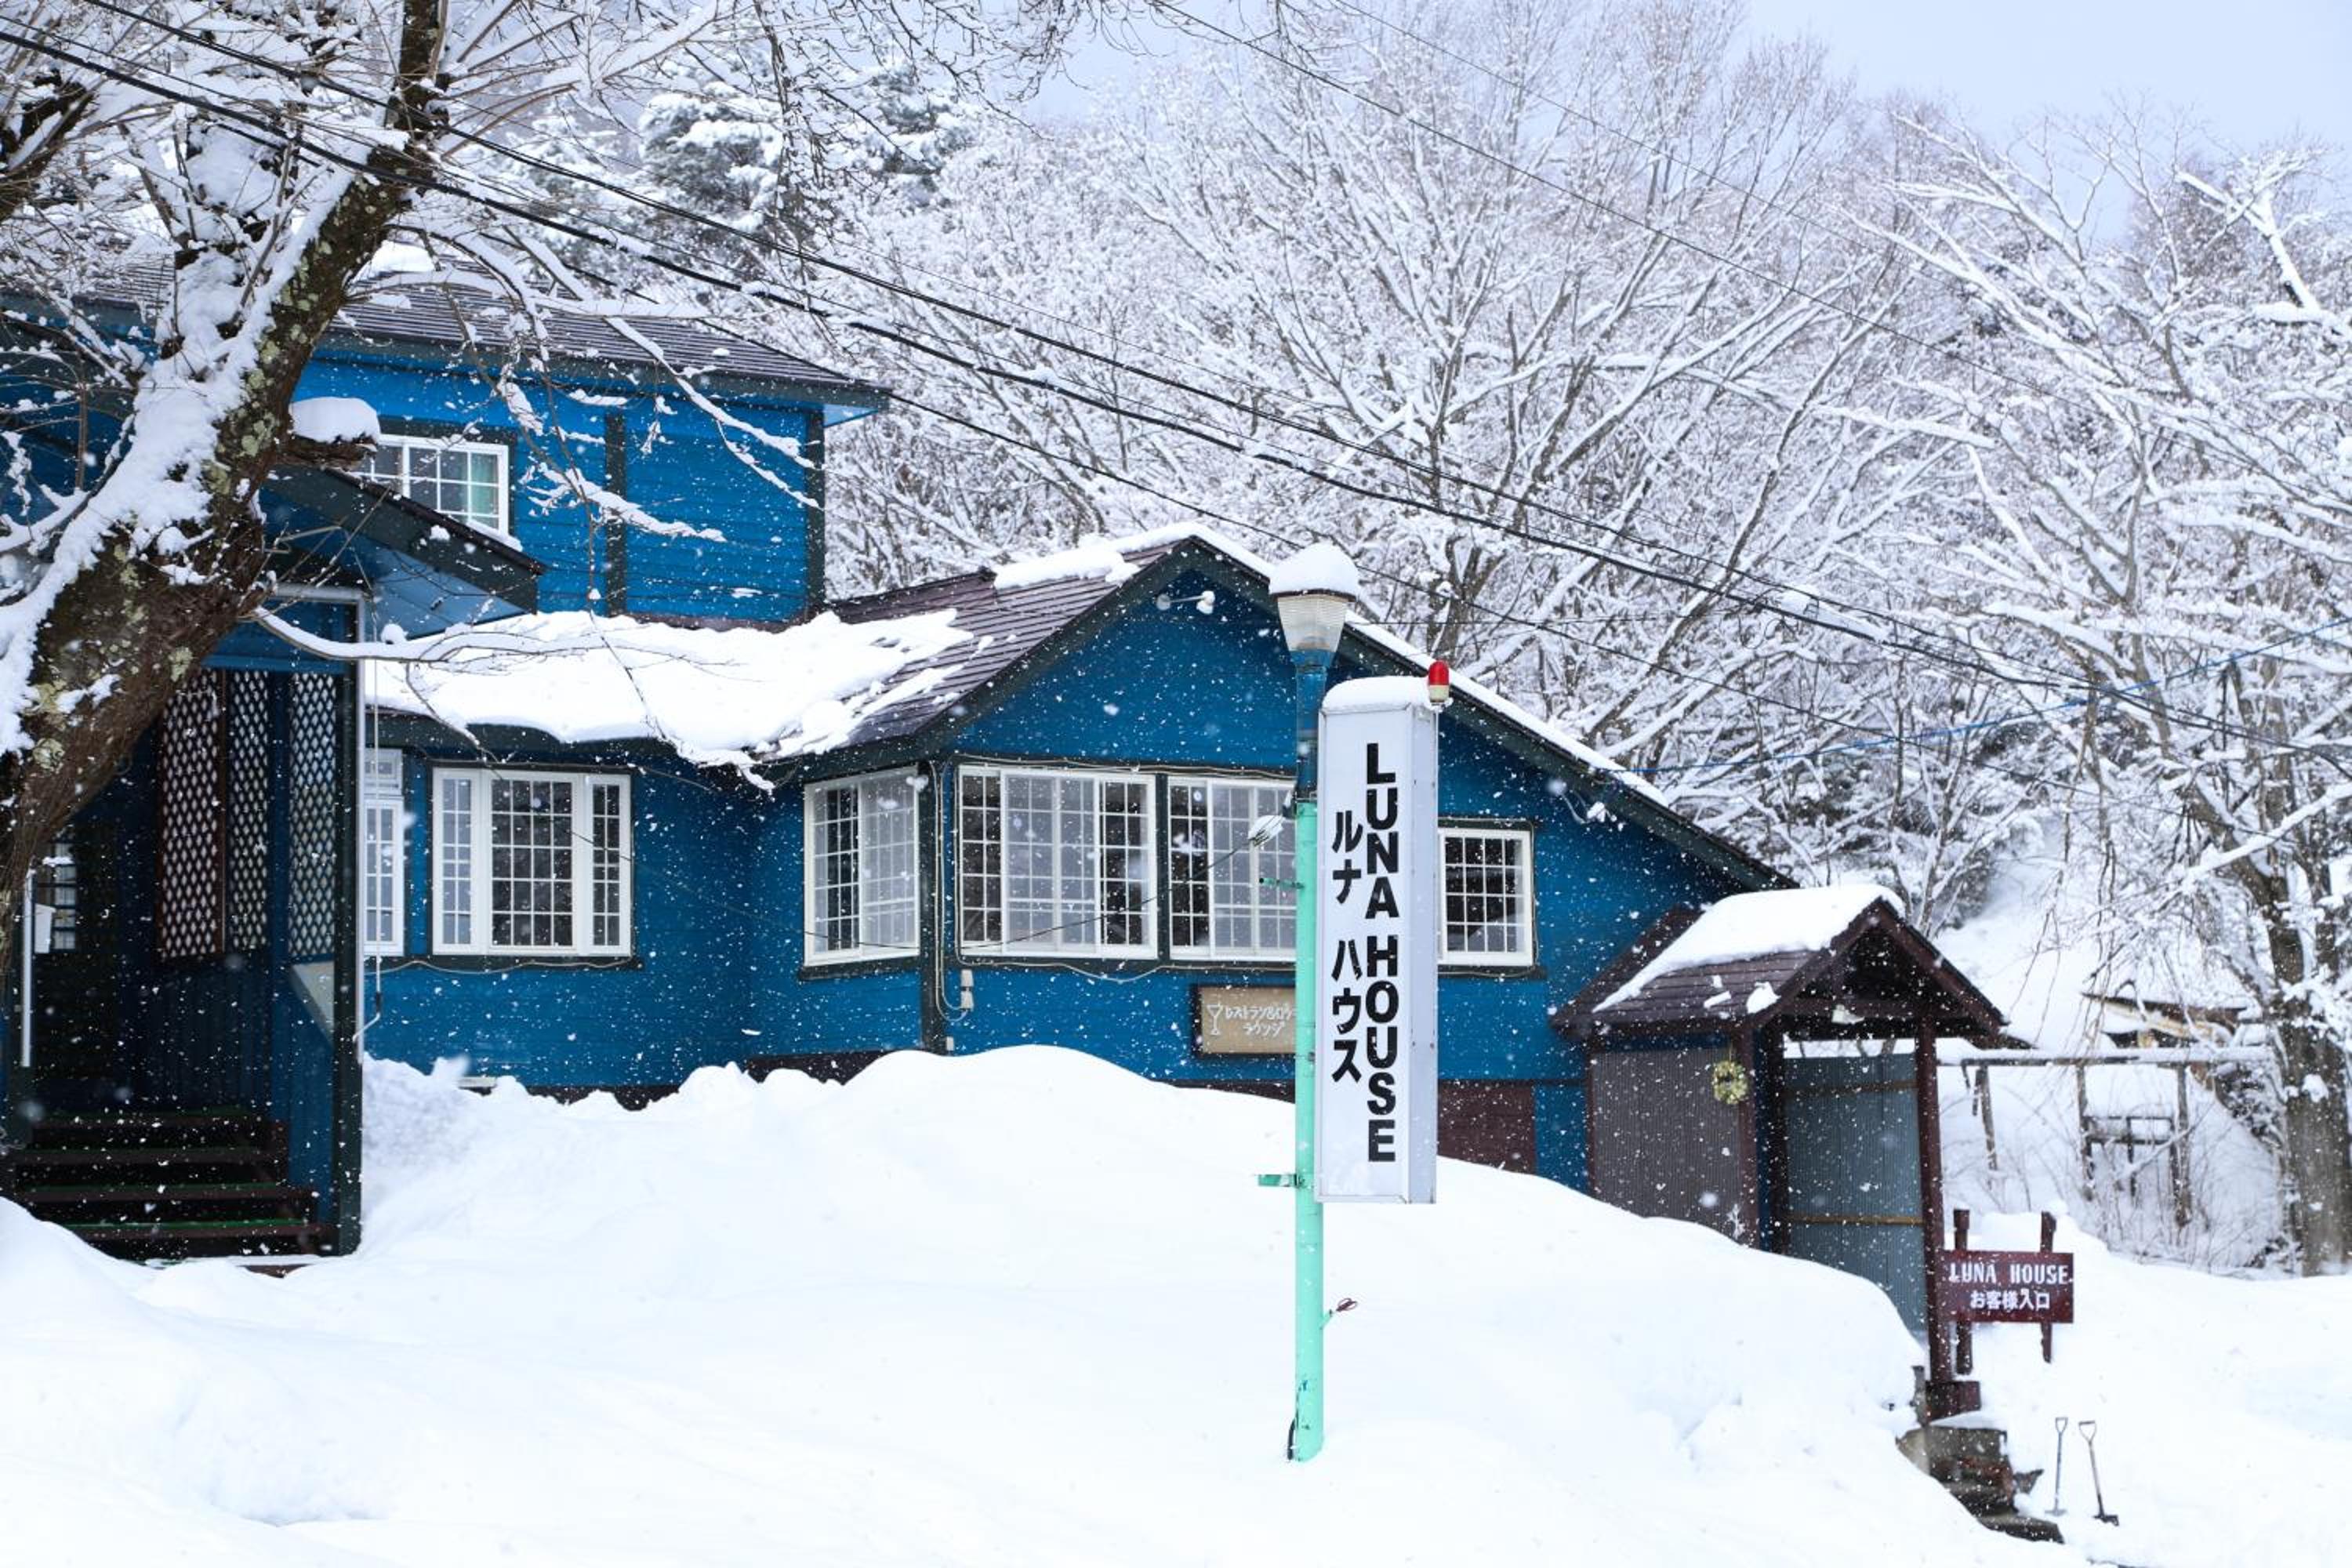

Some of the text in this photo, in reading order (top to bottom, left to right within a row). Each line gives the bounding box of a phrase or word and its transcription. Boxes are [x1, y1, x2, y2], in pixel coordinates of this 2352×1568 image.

[1332, 811, 1363, 1082] ルナ ハウス
[1366, 743, 1399, 1161] LUNA HOUSE
[1949, 1261, 2068, 1284] LUNA HOUSE
[1970, 1288, 2050, 1310] お客様入口
